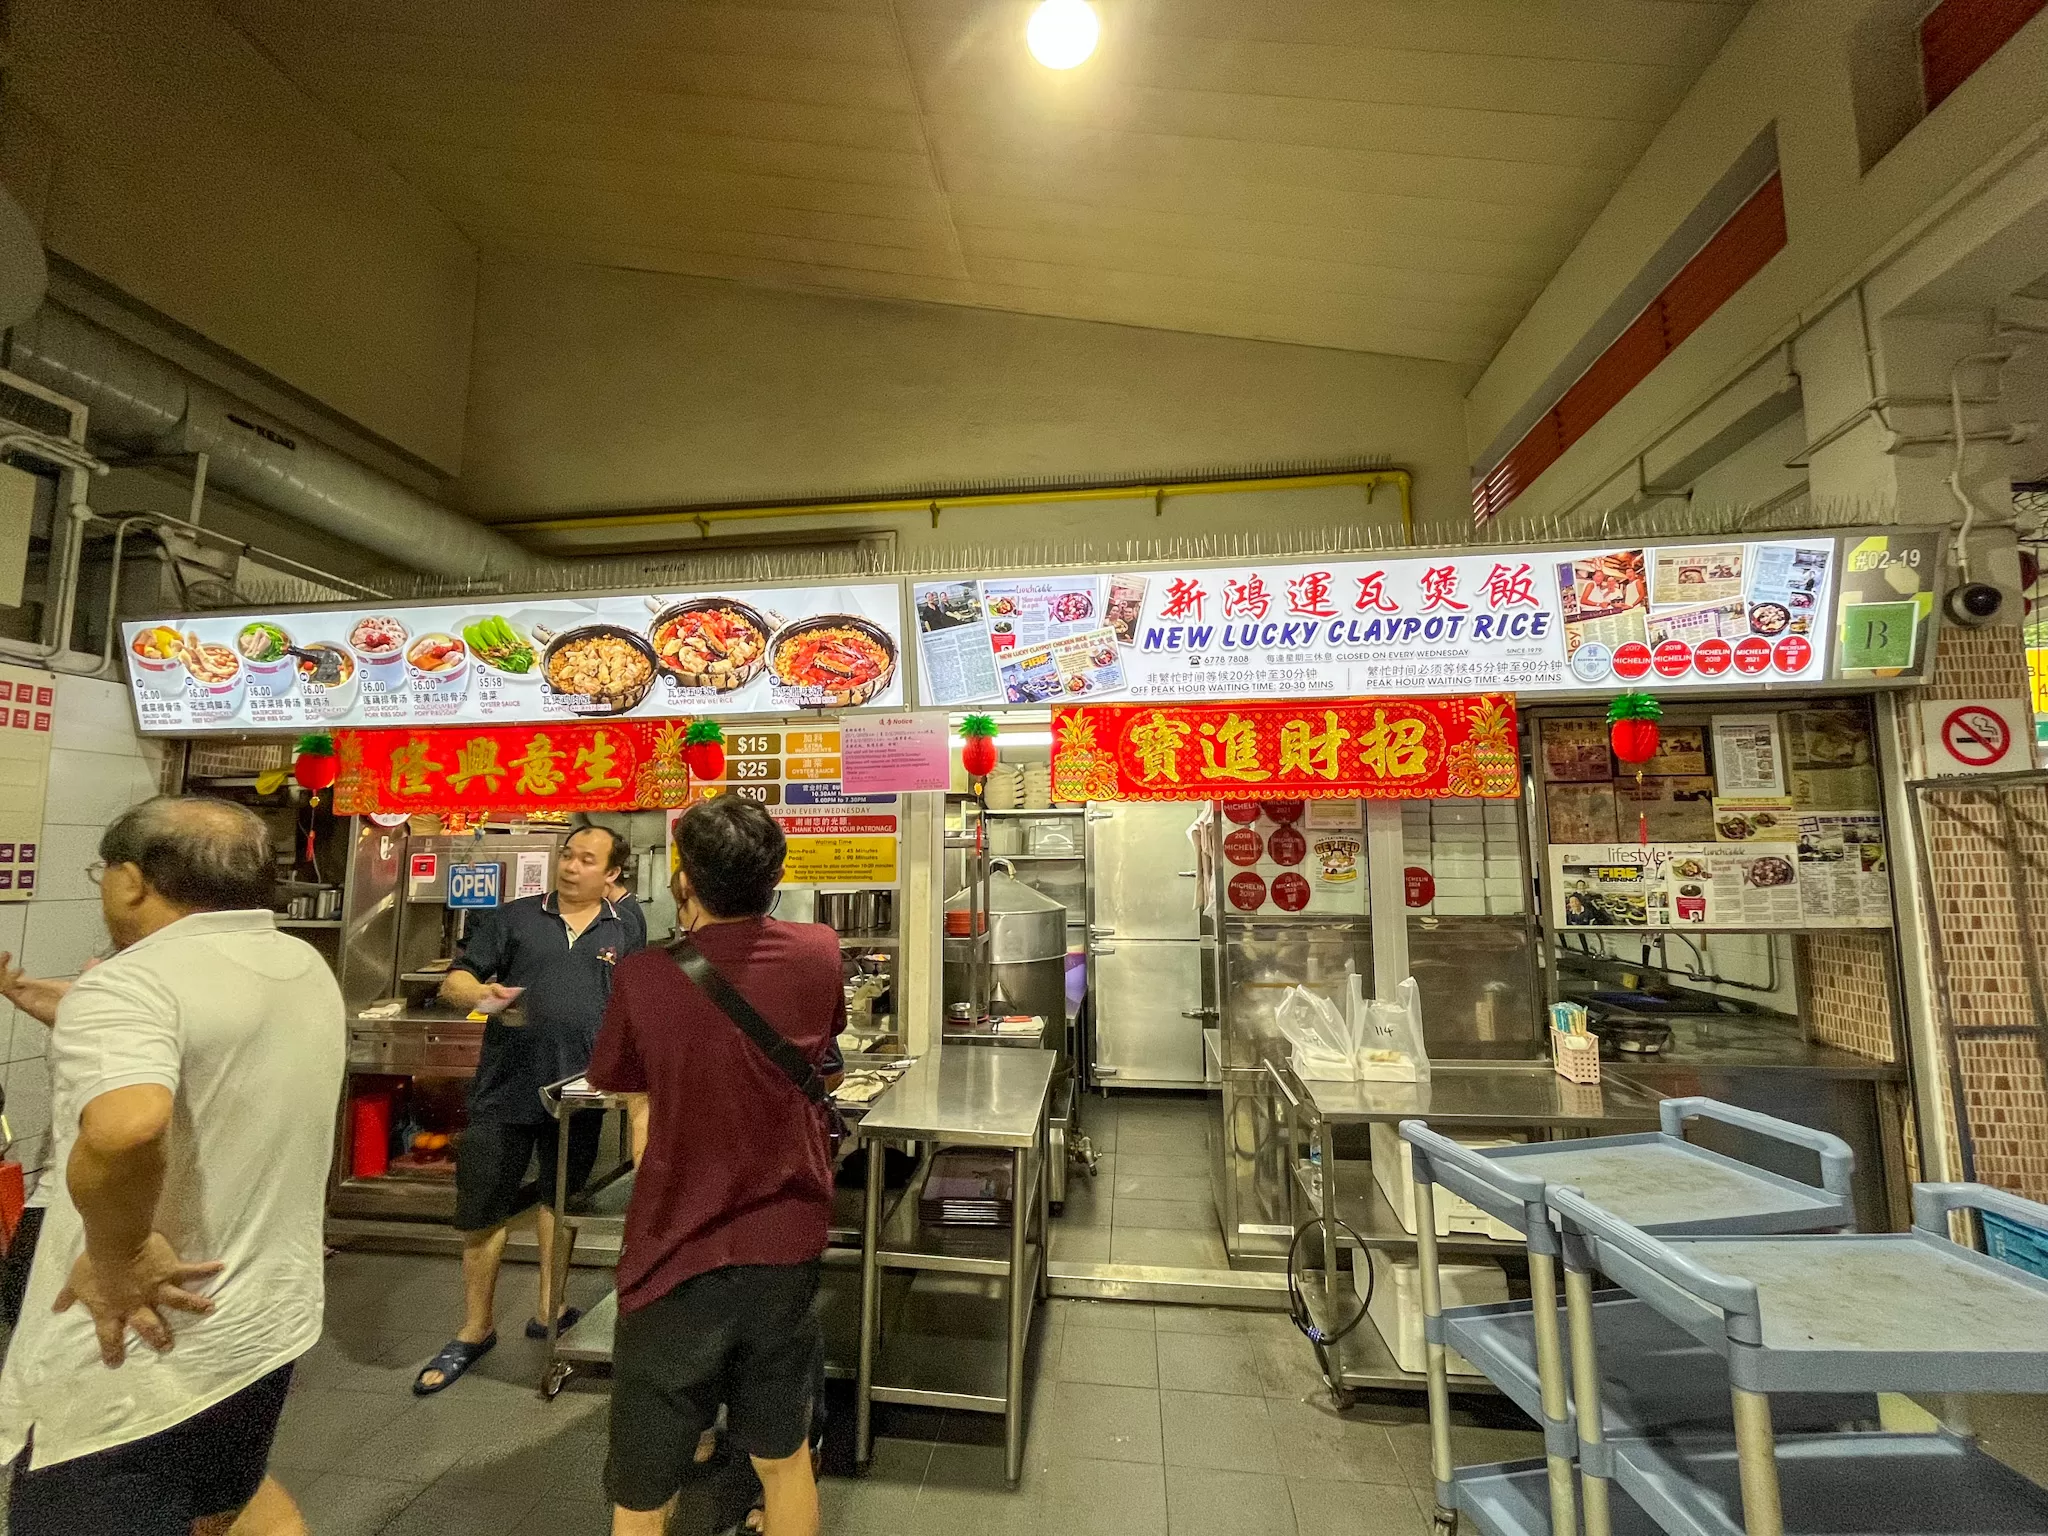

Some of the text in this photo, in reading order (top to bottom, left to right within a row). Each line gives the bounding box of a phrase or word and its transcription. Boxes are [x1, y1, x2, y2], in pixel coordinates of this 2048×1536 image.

[1855, 549, 1921, 570] #02-19
[1160, 563, 1540, 623] 新鴻運瓦煲飯
[1144, 612, 1551, 649] NEW LUCKY CLAYPOT RICE
[1864, 619, 1889, 650] B
[1030, 643, 1052, 653] CLAYPOT
[1053, 639, 1075, 648] CHICKEN
[1204, 655, 1250, 664] 6778 7808
[1337, 652, 1369, 660] CLOSED
[1389, 651, 1414, 659] EVERY
[1416, 649, 1469, 658] WEDNESDAY
[1654, 655, 1691, 663] MICHELIN
[1613, 657, 1651, 665] MICHELIN
[1367, 660, 1563, 677] 繁忙时间必须等候45分钟至90分钟
[771, 676, 778, 684] 10
[1148, 668, 1317, 684] 非繁忙时间等候20分钟至30分钟
[1366, 673, 1562, 687] PEAK HOUR WAITING TIME: 45-90 MINS
[303, 684, 325, 694] $6.00
[363, 682, 385, 692] $6.00
[413, 680, 436, 690] $6.00
[1130, 680, 1334, 694] OFF PEAK HOUR WAITING TIME: 20-30 MINS
[140, 691, 160, 700] $6.00
[189, 688, 209, 698] $6.00
[250, 686, 271, 696] $6.00
[479, 691, 497, 700] 油菜
[667, 687, 716, 698] 瓦煲五味饭
[304, 697, 330, 707] 黑鸡汤
[413, 692, 468, 703] 老黄瓜排骨汤
[250, 698, 300, 709] 西洋菜排骨汤
[803, 733, 823, 743] 加料
[737, 736, 768, 754] $15
[803, 758, 822, 768] 油菜
[737, 761, 768, 778] $25
[791, 768, 814, 776] OYSTER
[737, 786, 767, 802] $30
[824, 806, 871, 814] WEDNESDAY
[1224, 803, 1260, 811] MICHELIN
[856, 825, 894, 833] PATRONAGE.
[1608, 847, 1666, 867] lifestyle
[1600, 867, 1638, 878] FIRE
[451, 874, 497, 898] OPEN
[1230, 882, 1264, 891] MICHELIN
[1374, 1025, 1394, 1037] 114
